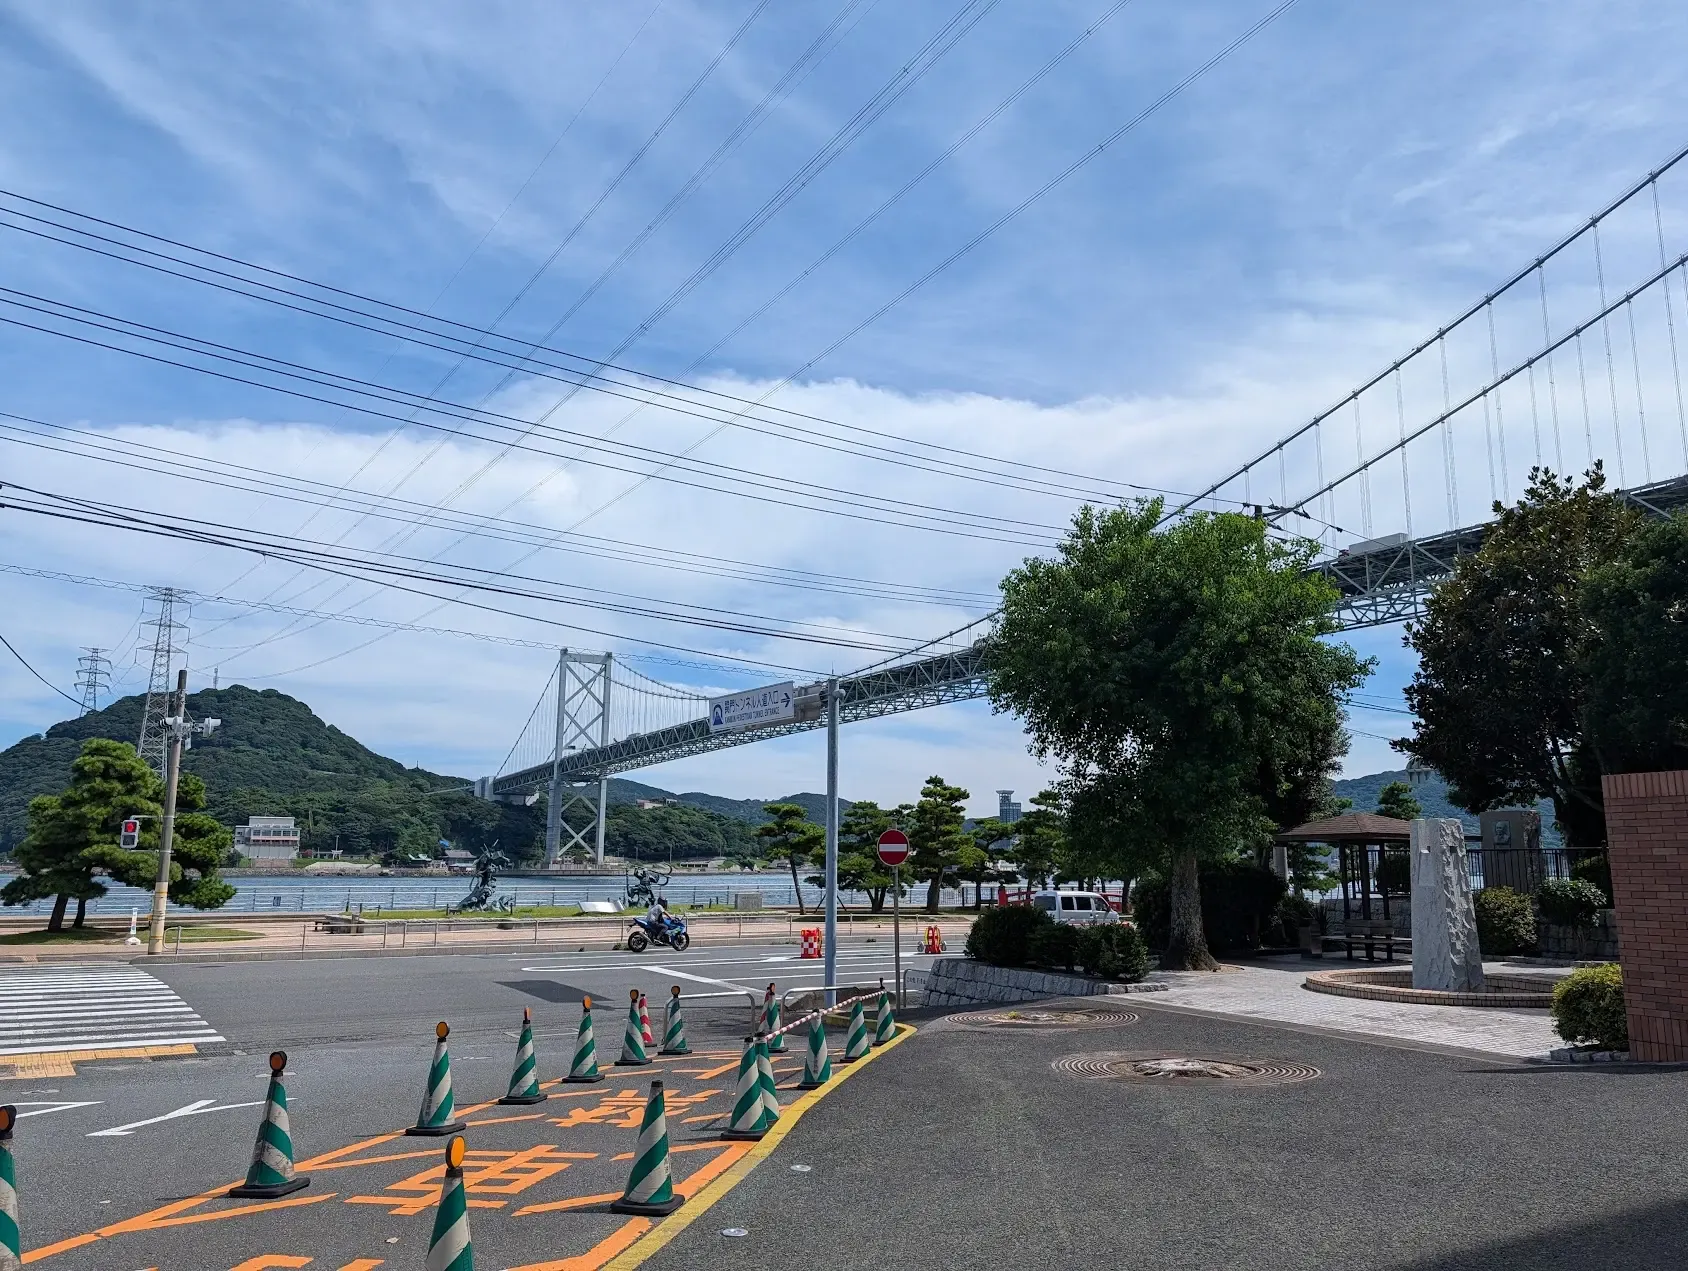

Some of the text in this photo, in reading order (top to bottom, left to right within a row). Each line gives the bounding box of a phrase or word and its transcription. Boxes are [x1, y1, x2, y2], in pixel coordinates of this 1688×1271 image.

[724, 690, 779, 715] 関門トンネル人道入口
